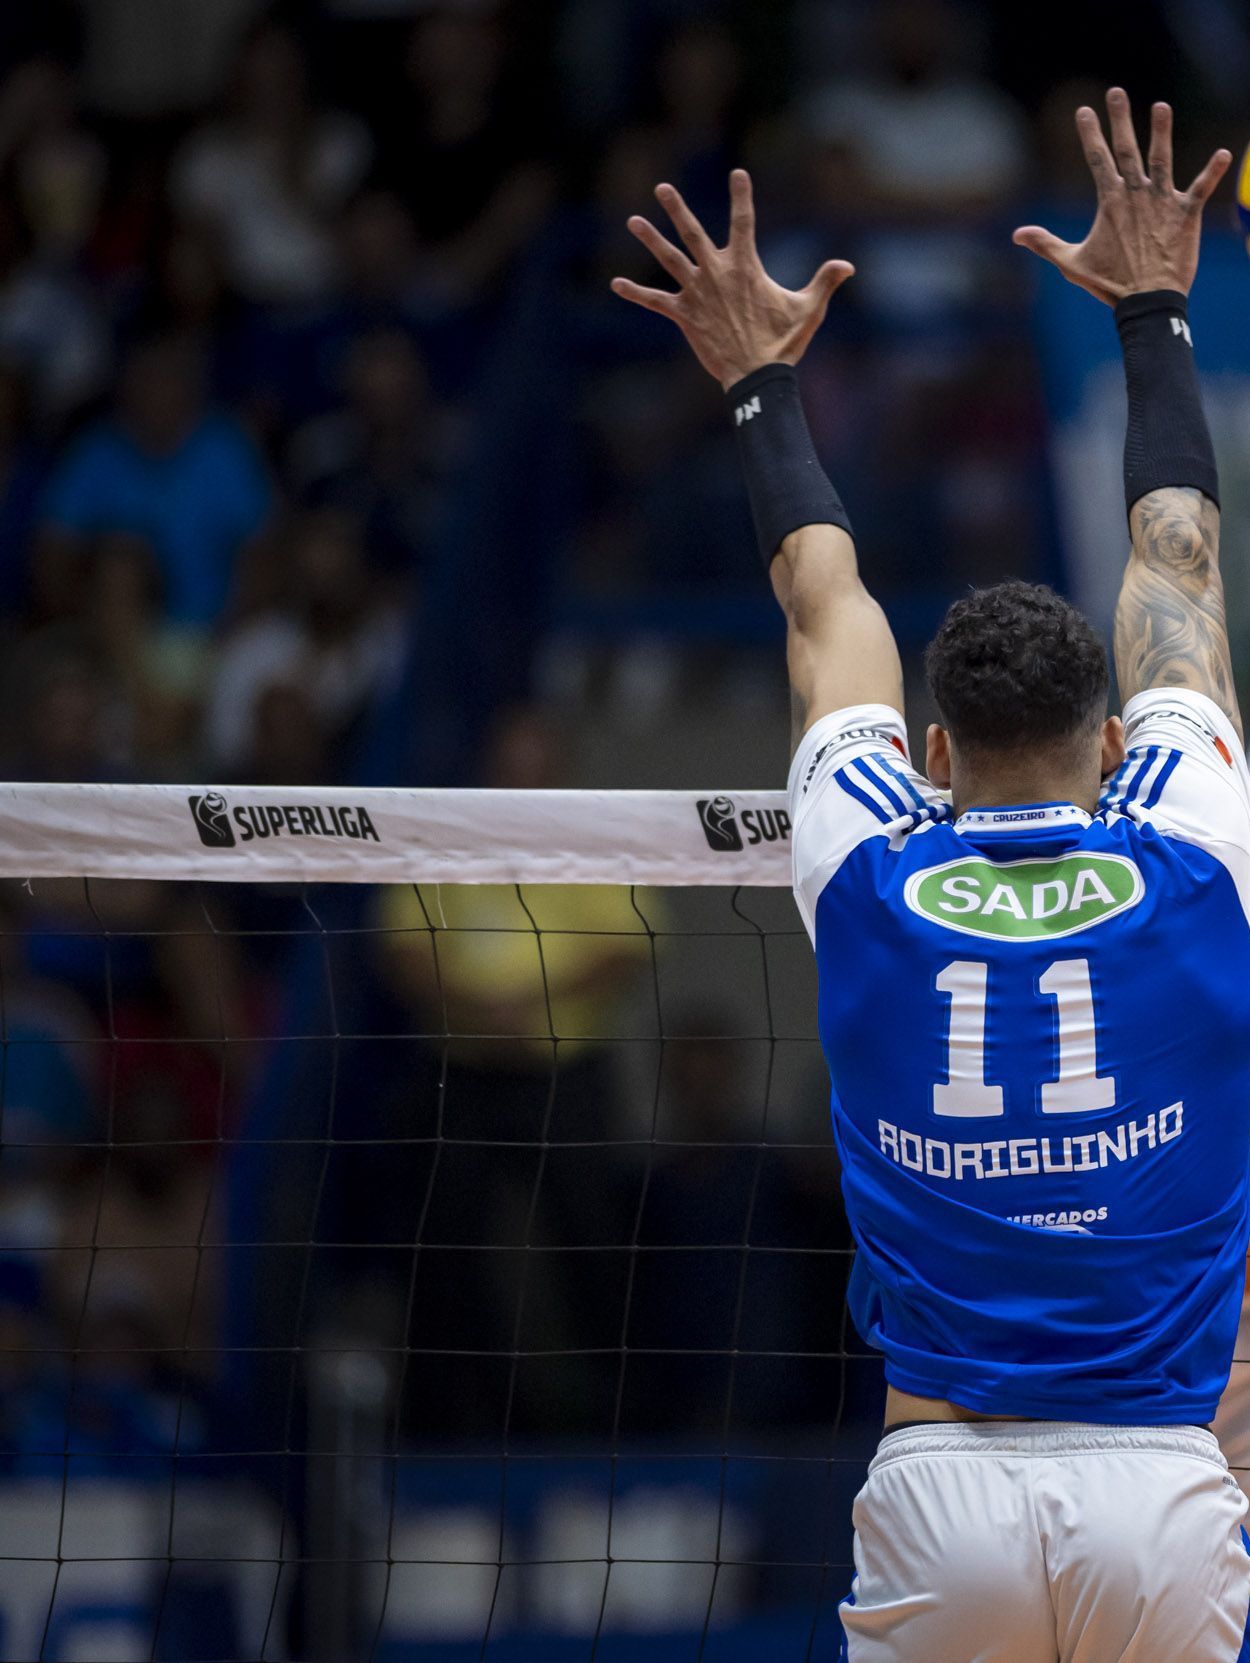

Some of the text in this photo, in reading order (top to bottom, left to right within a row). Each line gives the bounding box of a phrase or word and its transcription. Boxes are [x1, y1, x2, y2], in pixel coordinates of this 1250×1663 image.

[233, 806, 381, 842] SUPERLIGA
[740, 809, 792, 845] SUP
[992, 810, 1046, 823] CRUZEIRO
[937, 868, 1117, 920] SADA
[932, 958, 1117, 1118] 11
[878, 1101, 1184, 1181] RODRIGUINHO
